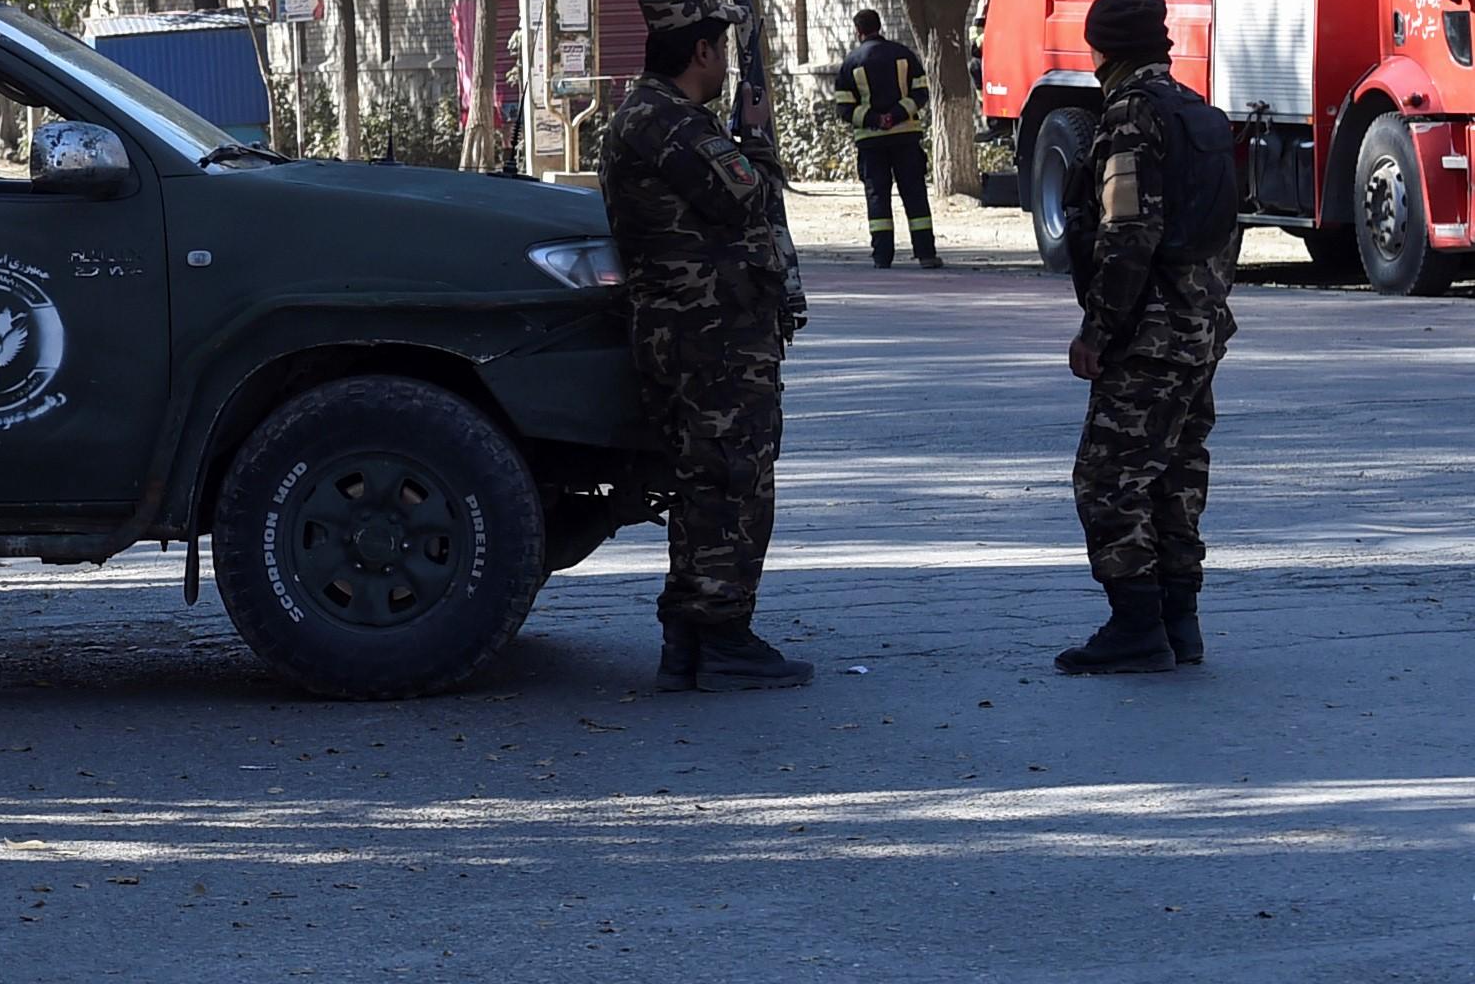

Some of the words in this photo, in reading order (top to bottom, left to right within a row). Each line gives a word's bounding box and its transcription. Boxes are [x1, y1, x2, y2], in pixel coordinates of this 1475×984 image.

[272, 460, 308, 506] MUD
[262, 511, 305, 624] SCORPION
[465, 494, 489, 578] PIRELLI
